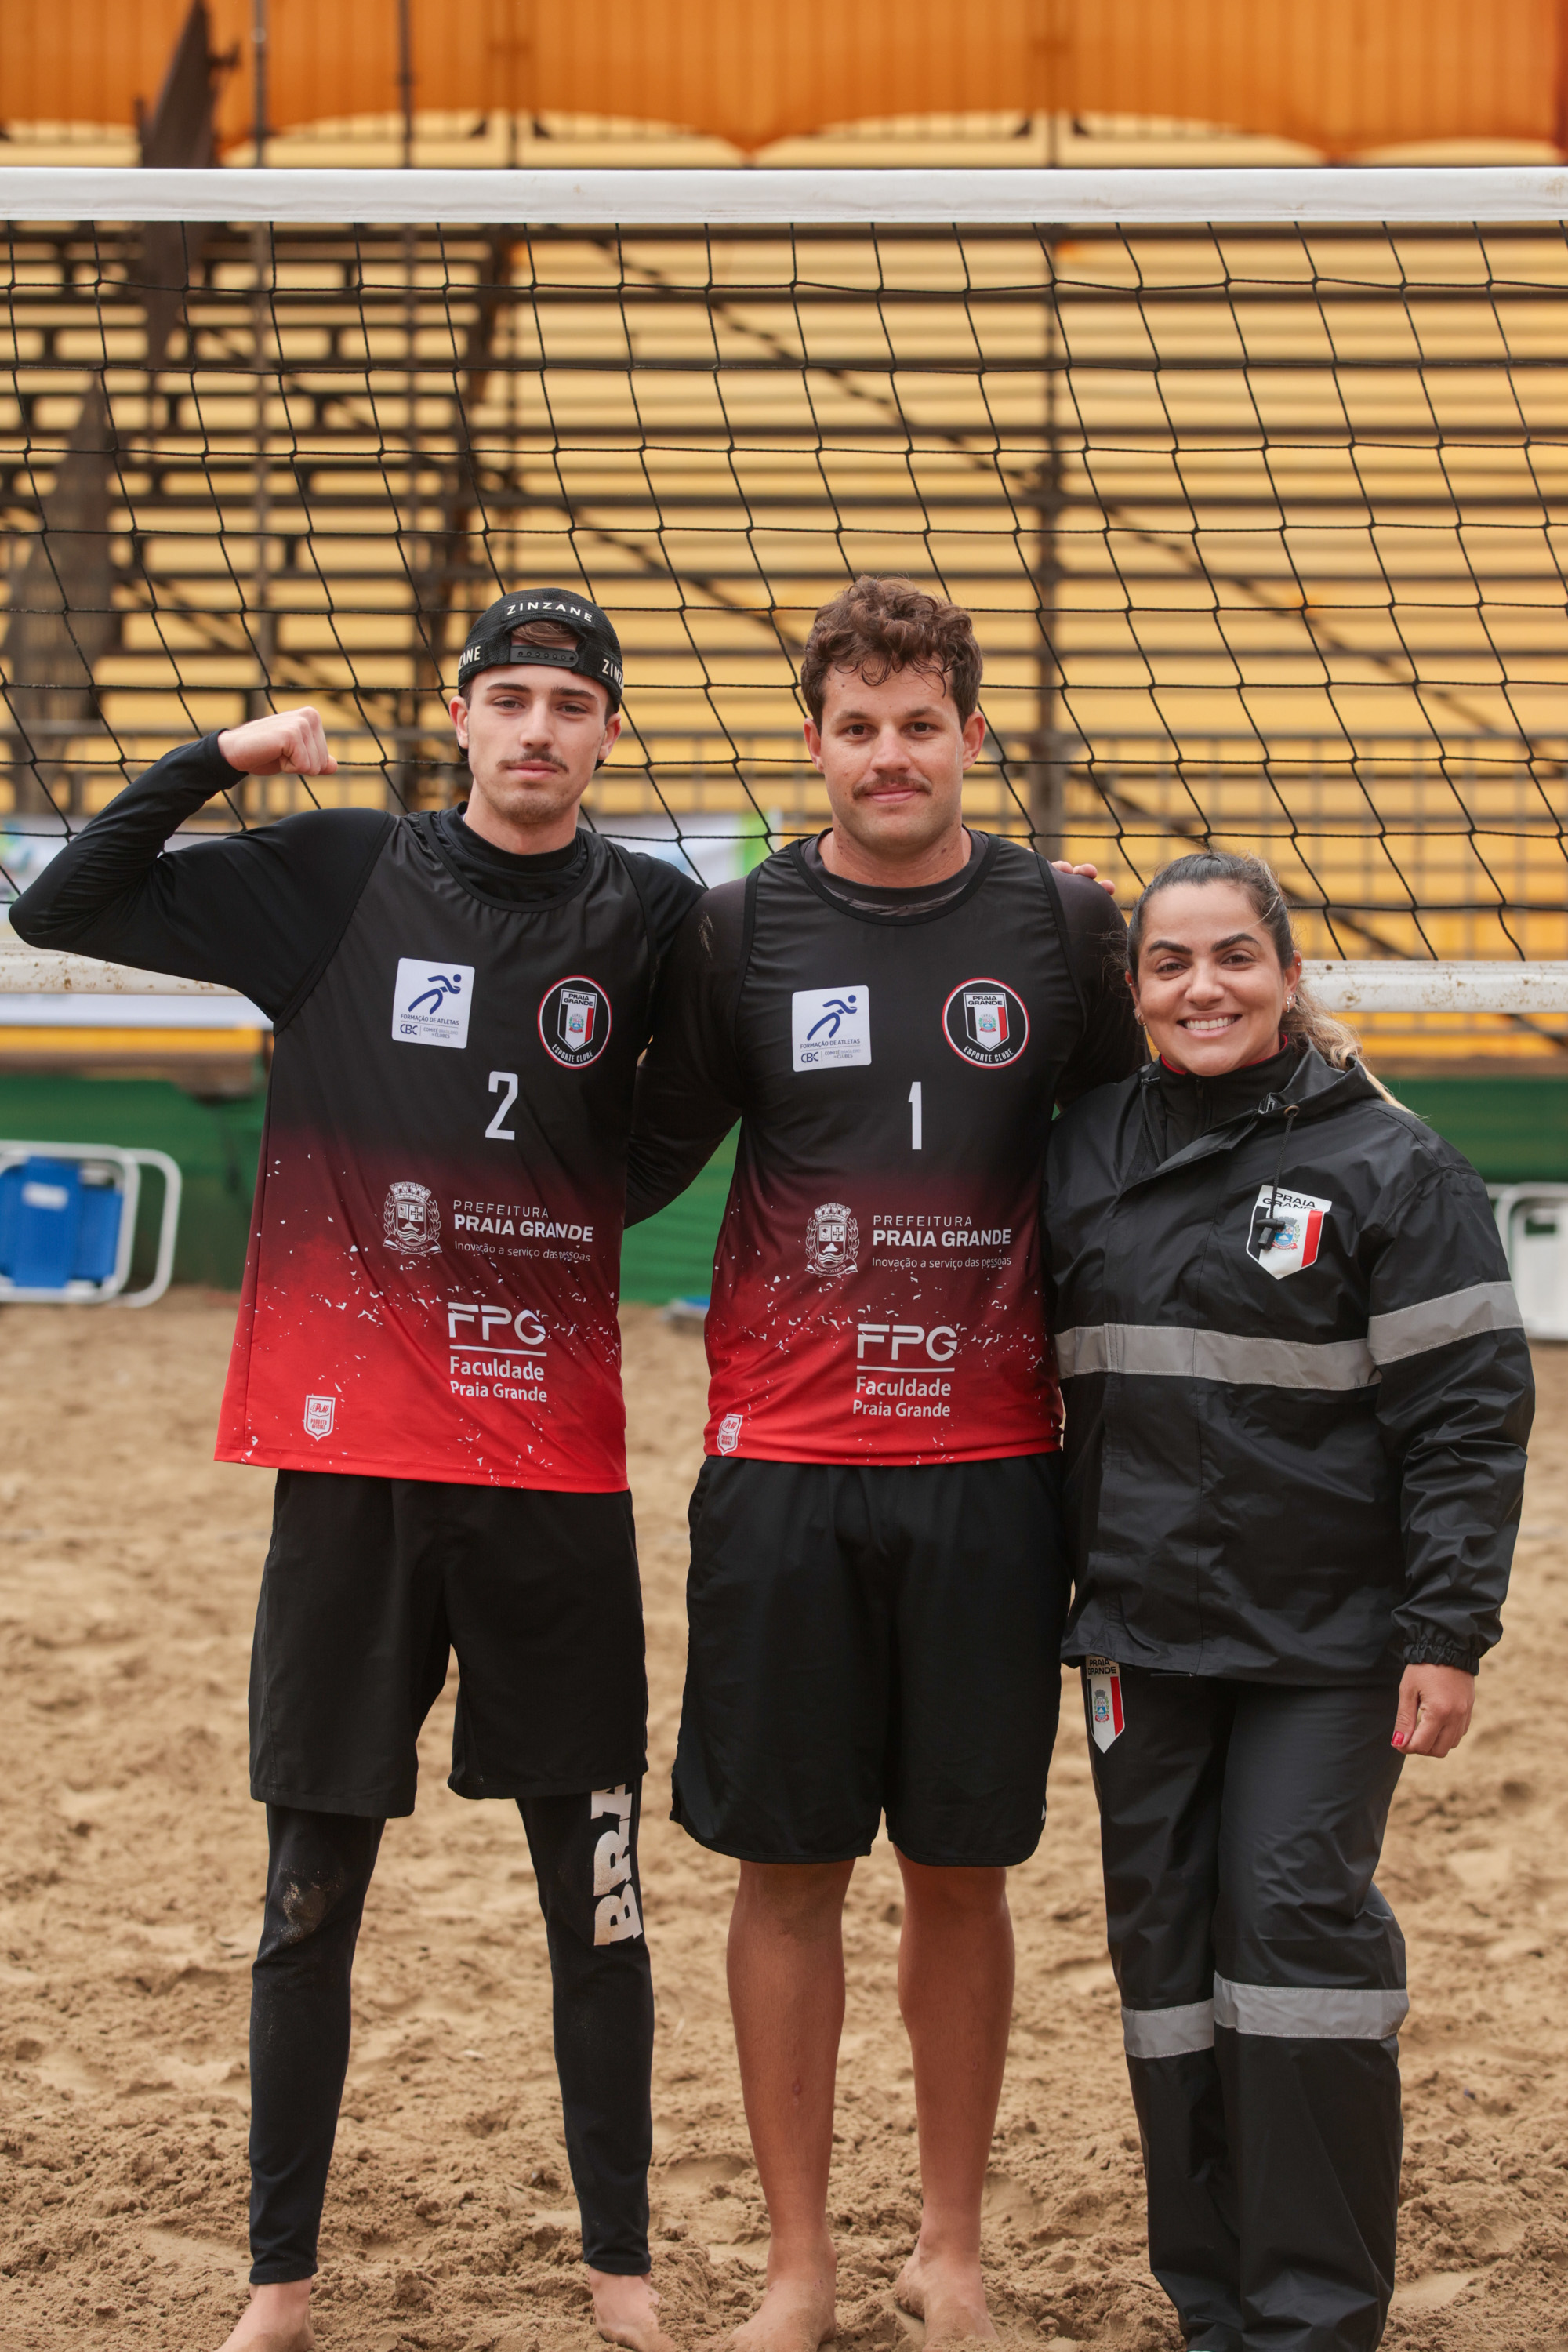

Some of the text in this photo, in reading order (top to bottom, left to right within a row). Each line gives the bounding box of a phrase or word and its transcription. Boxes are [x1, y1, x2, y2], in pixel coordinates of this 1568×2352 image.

[506, 601, 593, 622] ZINZANE
[564, 997, 593, 1007] GRANDE
[401, 1013, 429, 1022] FORMAÇÃO
[400, 1023, 418, 1035] CBC
[552, 1044, 593, 1062] ESPORTE CLUBE
[800, 1040, 829, 1049] FORMAÇÃO
[963, 1045, 1014, 1062] ESPORTE CLUBE
[800, 1051, 819, 1063] CBC
[485, 1070, 518, 1141] 2
[908, 1081, 922, 1150] 1
[453, 1200, 549, 1218] PREFEITURA
[1274, 1192, 1316, 1208] PRAIA
[454, 1214, 594, 1243] PRAIA GRANDE
[873, 1215, 972, 1227] PREFEITURA
[873, 1229, 1011, 1247] PRAIA GRANDE
[455, 1240, 495, 1254] Inovação
[507, 1247, 540, 1259] serviço
[543, 1248, 558, 1259] das
[559, 1250, 591, 1262] pessoas
[872, 1256, 1011, 1271] Inovação a serviço das pessoas
[448, 1301, 546, 1345] FPG
[856, 1323, 958, 1362] FPG
[449, 1356, 545, 1381] Faculdade
[450, 1381, 547, 1403] Praia Grande
[855, 1376, 951, 1397] Faculdade
[852, 1399, 951, 1417] Praia Grande
[1087, 1666, 1117, 1675] GRANDE
[1089, 1658, 1110, 1667] PRAIA
